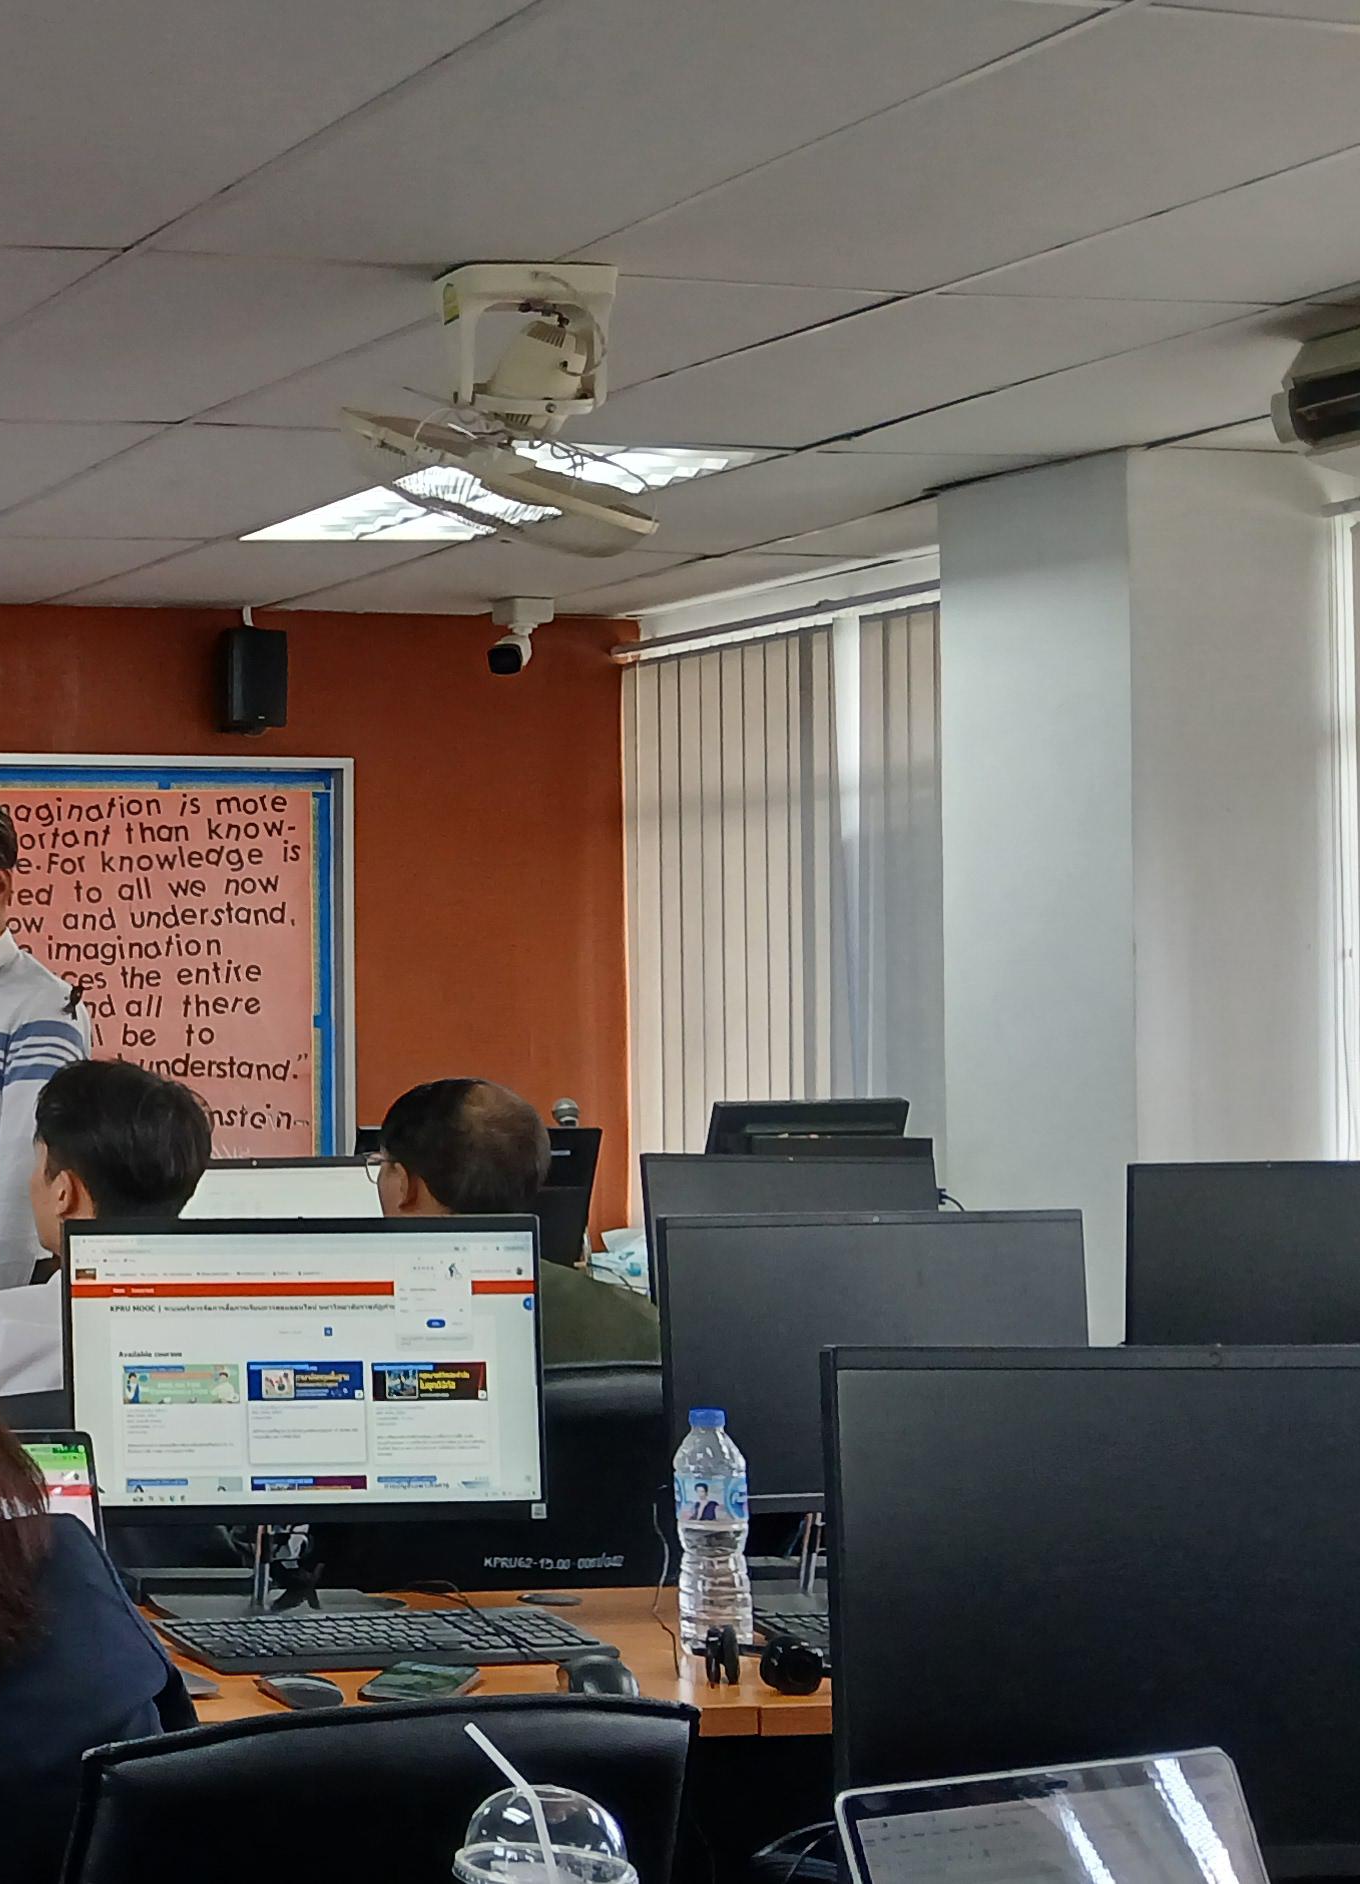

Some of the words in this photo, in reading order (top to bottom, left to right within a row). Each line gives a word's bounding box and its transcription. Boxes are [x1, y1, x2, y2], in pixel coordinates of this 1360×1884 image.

[180, 794, 201, 816] is
[216, 794, 288, 815] more
[126, 822, 189, 845] than
[207, 818, 296, 842] know-
[100, 845, 264, 873] knowledge
[282, 840, 302, 862] is
[74, 880, 103, 904] to
[118, 877, 152, 901] all
[168, 879, 207, 898] we
[224, 875, 280, 897] now
[62, 907, 117, 931] and
[47, 933, 222, 966] imagination
[121, 966, 162, 989] the
[176, 959, 262, 986] entire
[125, 994, 163, 1018] all
[182, 993, 262, 1018] there
[122, 1023, 156, 1047] be
[185, 1023, 215, 1047] to
